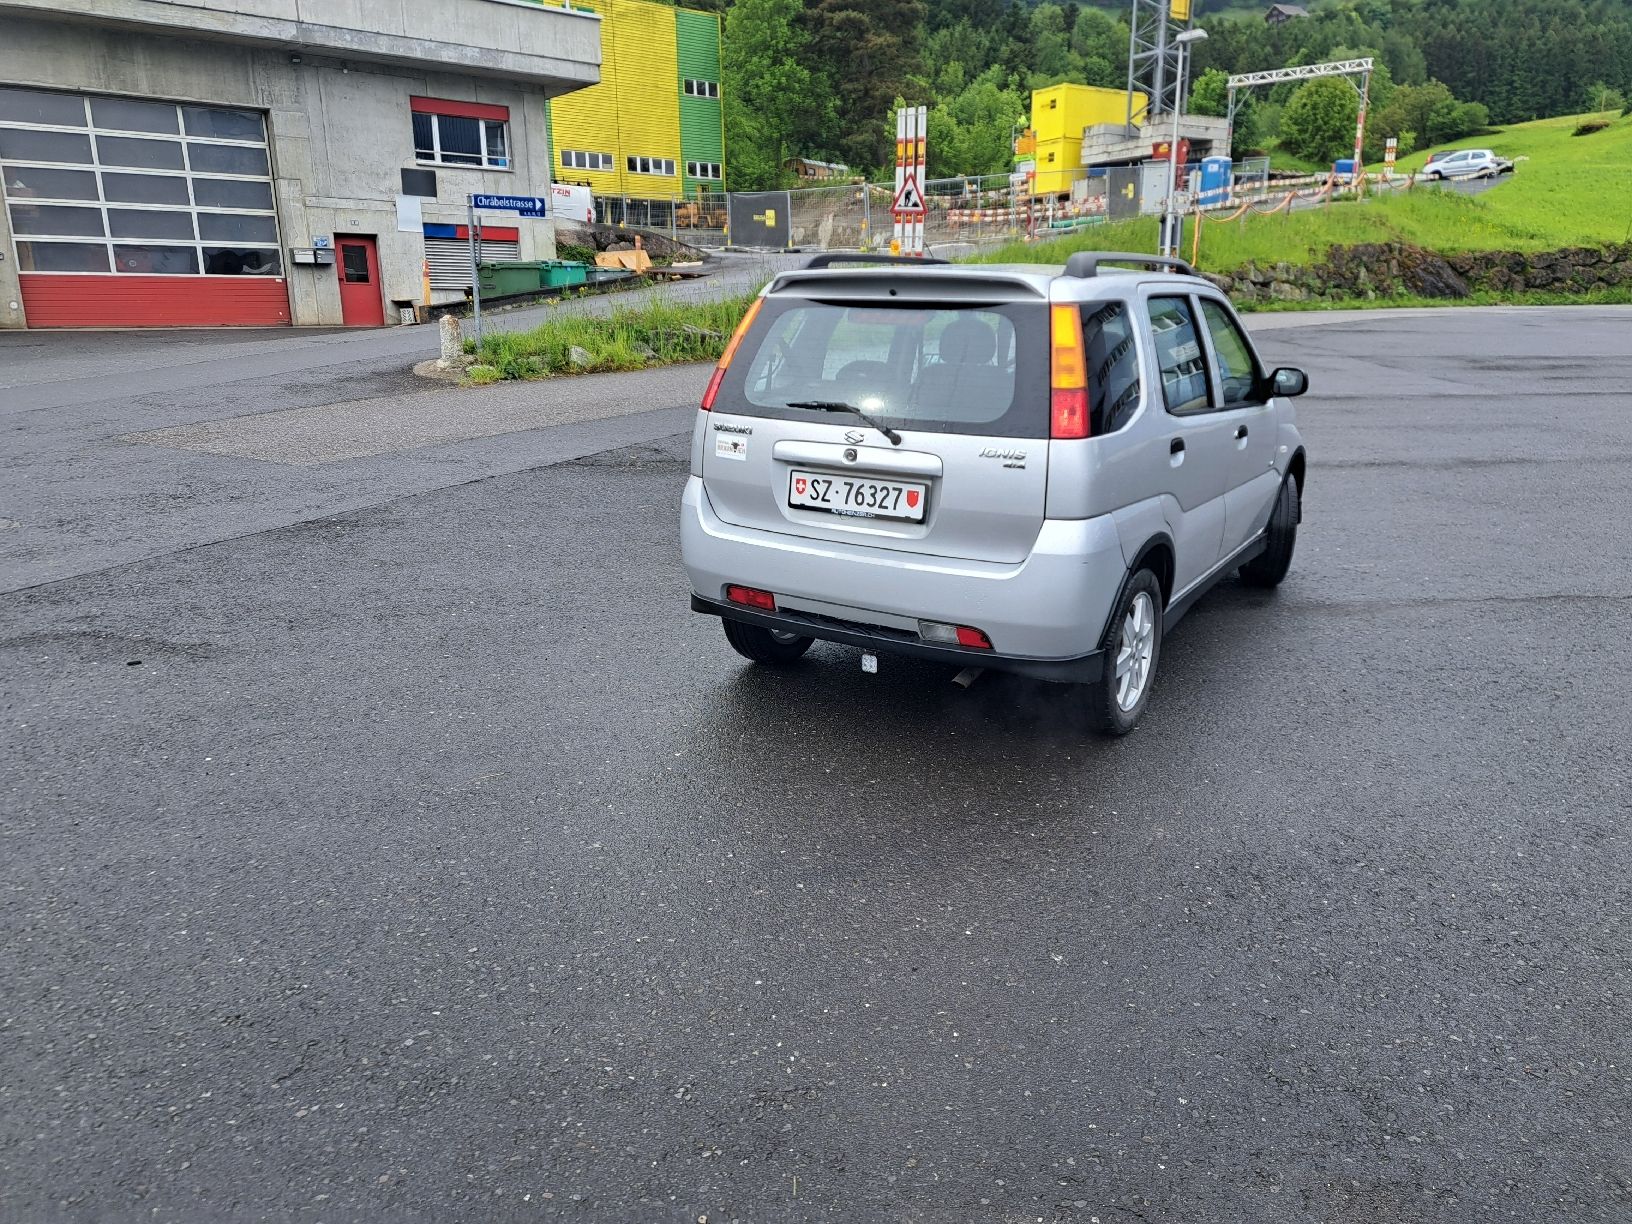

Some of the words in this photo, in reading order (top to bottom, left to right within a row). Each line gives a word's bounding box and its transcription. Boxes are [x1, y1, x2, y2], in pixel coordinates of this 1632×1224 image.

[477, 196, 534, 209] Chräbelstrasse
[713, 423, 753, 436] SUZUKI
[979, 447, 1026, 460] IGNIS
